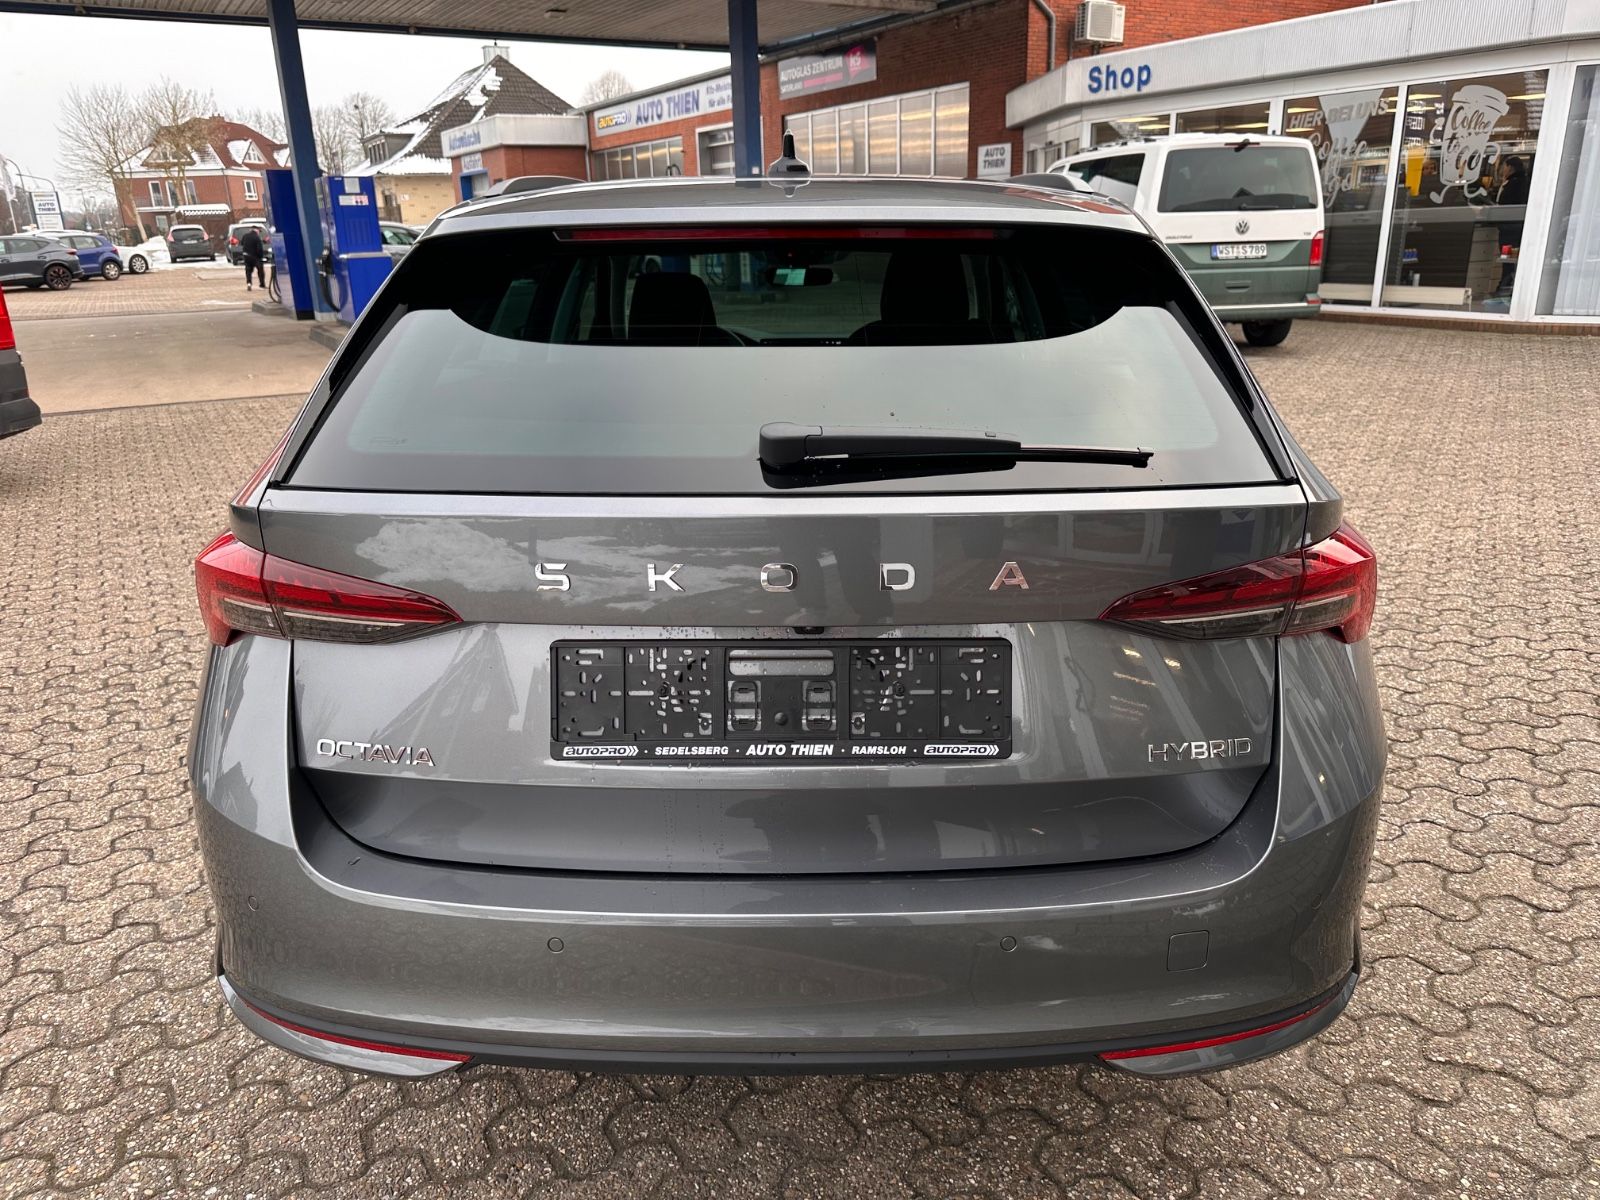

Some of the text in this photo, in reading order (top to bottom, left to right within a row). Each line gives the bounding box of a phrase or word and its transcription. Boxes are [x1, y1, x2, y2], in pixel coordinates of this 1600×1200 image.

[780, 56, 843, 82] AUTOGLAS ZENTRUM
[1088, 64, 1151, 94] Shop
[636, 99, 663, 125] AUTO
[666, 89, 700, 118] THIEN
[1289, 111, 1323, 129] HIER
[1325, 104, 1353, 124] BEI
[1353, 99, 1390, 119] UNS
[1451, 105, 1492, 134] Coffee
[983, 158, 1006, 169] THIEN
[984, 147, 1006, 158] AUTO
[1218, 245, 1235, 256] WST
[316, 738, 436, 767] OCTAVIA
[655, 746, 729, 755] SEDELSBERG
[746, 744, 787, 756] AUTO
[790, 744, 834, 756] THIEN
[851, 745, 907, 755] RAMSLOH
[1147, 737, 1253, 763] HYBRID
